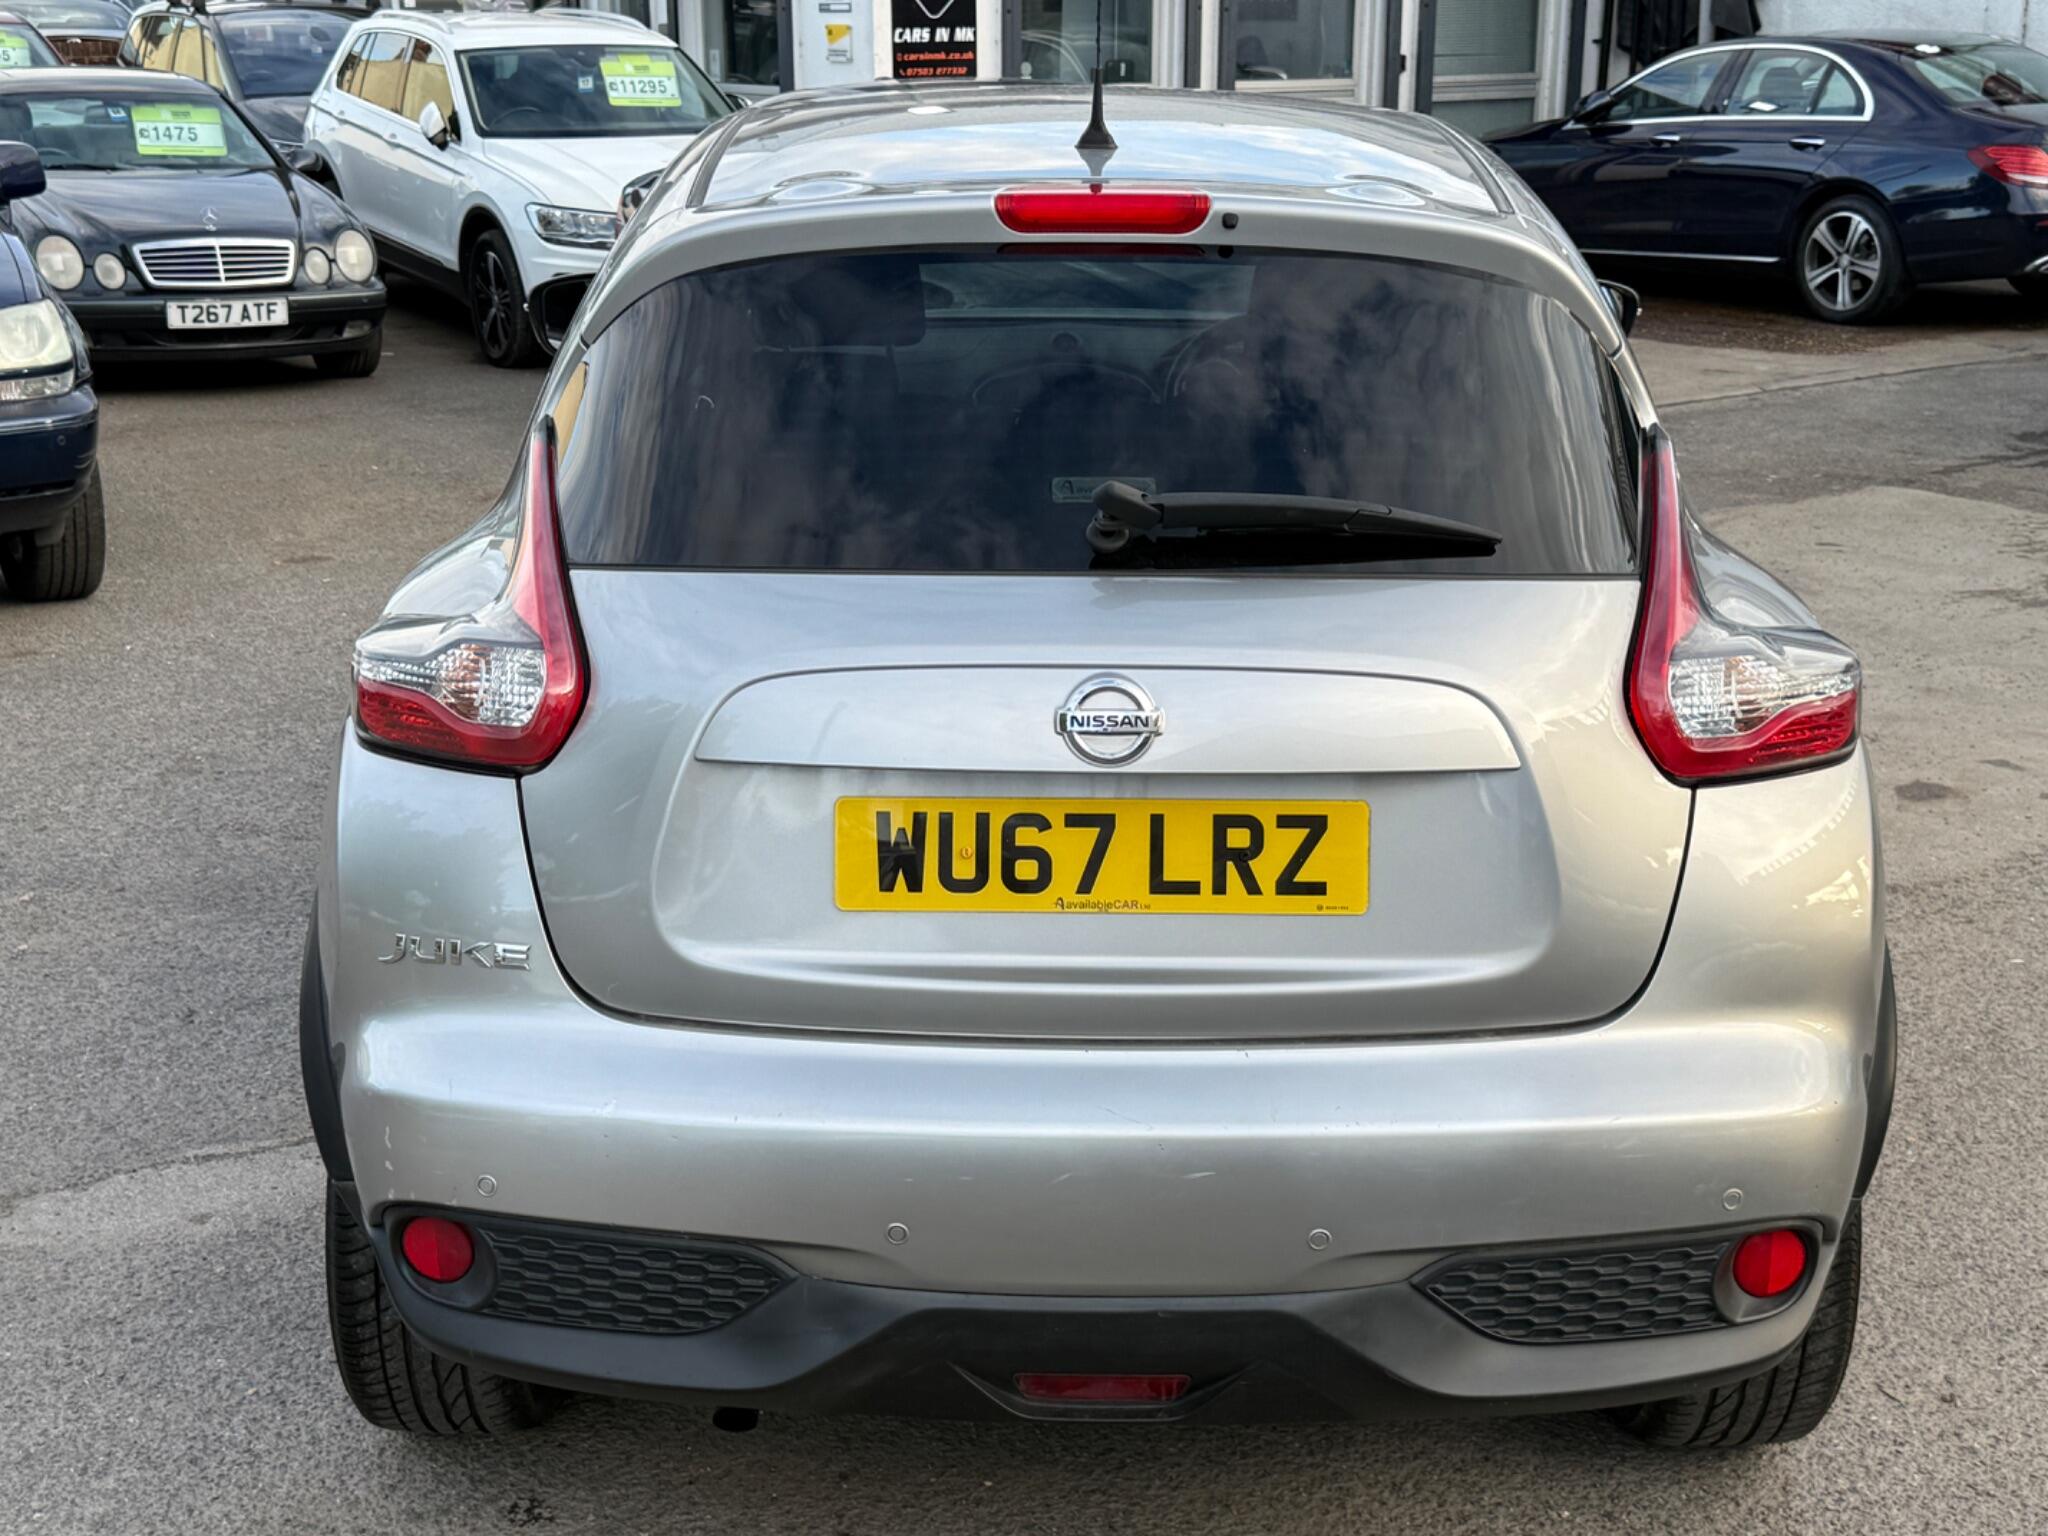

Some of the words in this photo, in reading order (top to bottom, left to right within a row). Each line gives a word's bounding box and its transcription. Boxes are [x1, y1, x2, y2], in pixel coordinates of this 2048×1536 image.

[894, 27, 931, 43] CARS
[935, 27, 950, 43] IN
[954, 26, 975, 42] MK
[176, 304, 232, 323] T267
[241, 302, 278, 322] ATF
[1069, 714, 1150, 728] NISSAN
[875, 810, 1116, 895] WU67
[1149, 813, 1328, 896] LRZ
[377, 932, 532, 970] JUKE
